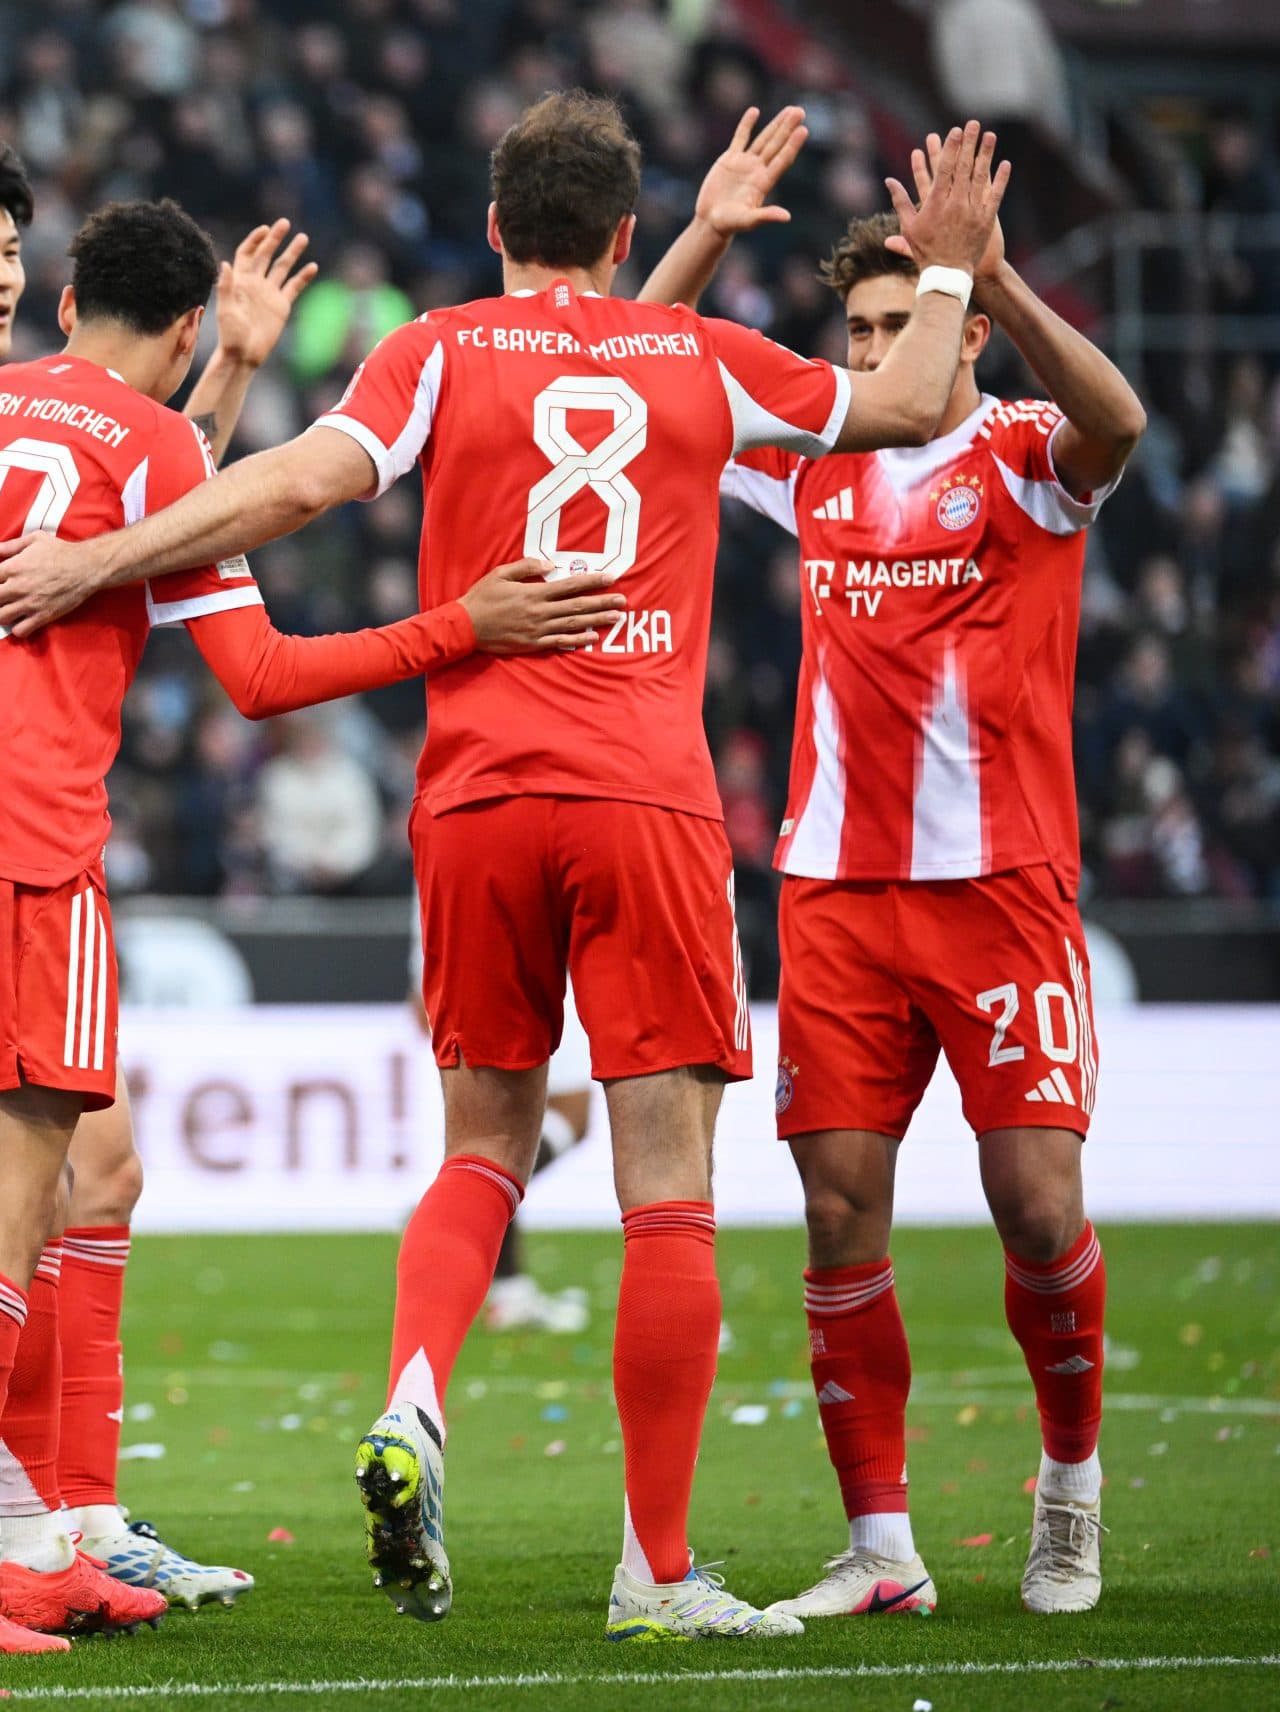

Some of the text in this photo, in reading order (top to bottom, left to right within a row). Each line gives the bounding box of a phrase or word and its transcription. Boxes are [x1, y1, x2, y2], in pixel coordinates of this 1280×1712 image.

[457, 326, 488, 348] FC
[523, 376, 648, 583] 8
[845, 557, 984, 588] MAGENTA
[845, 590, 884, 618] TV
[558, 609, 673, 653] ZKA
[976, 981, 1078, 1068] 20
[123, 1050, 406, 1173] en!
